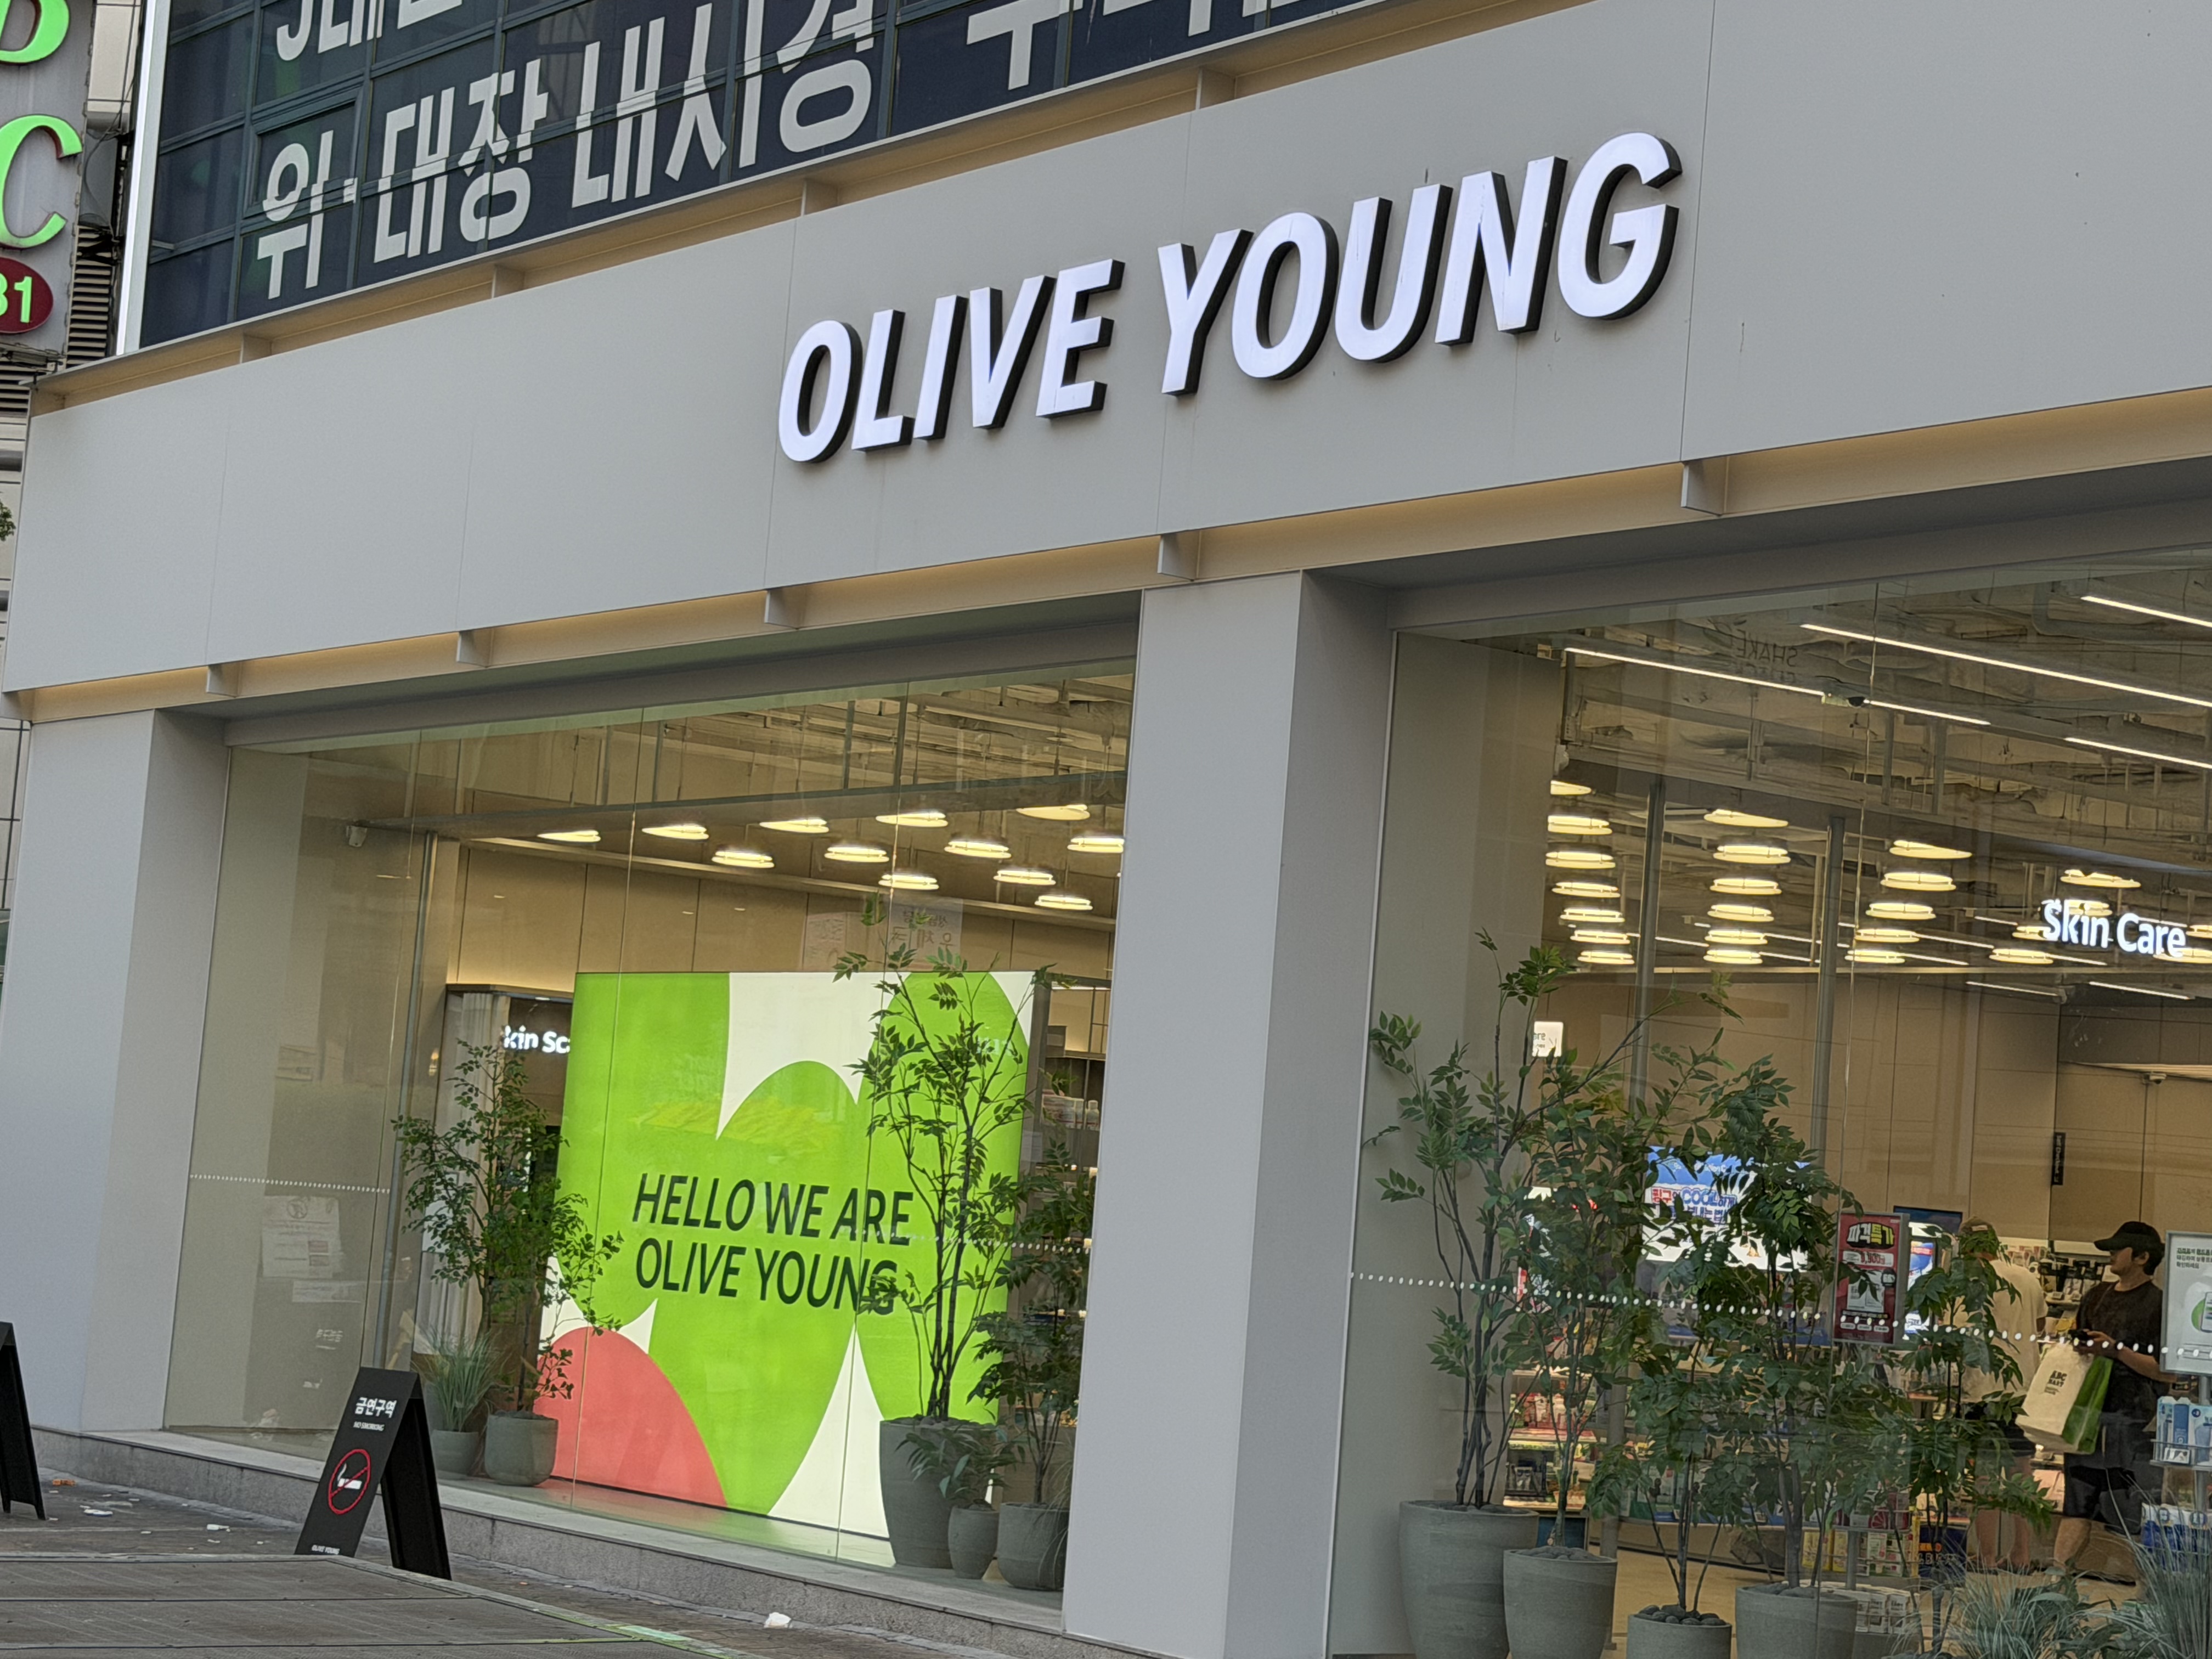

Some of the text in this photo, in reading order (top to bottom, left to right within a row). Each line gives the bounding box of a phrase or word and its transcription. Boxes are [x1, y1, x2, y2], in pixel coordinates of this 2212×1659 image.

[572, 0, 874, 208] 내시경
[777, 131, 1683, 462] OLIVE YOUNG
[2043, 898, 2186, 958] Skin Care
[503, 1025, 571, 1053] kin Sc
[633, 1173, 913, 1245] HELLO WE ARE
[636, 1237, 898, 1316] OLIVE YOUNG
[355, 1397, 397, 1418] 금연구역
